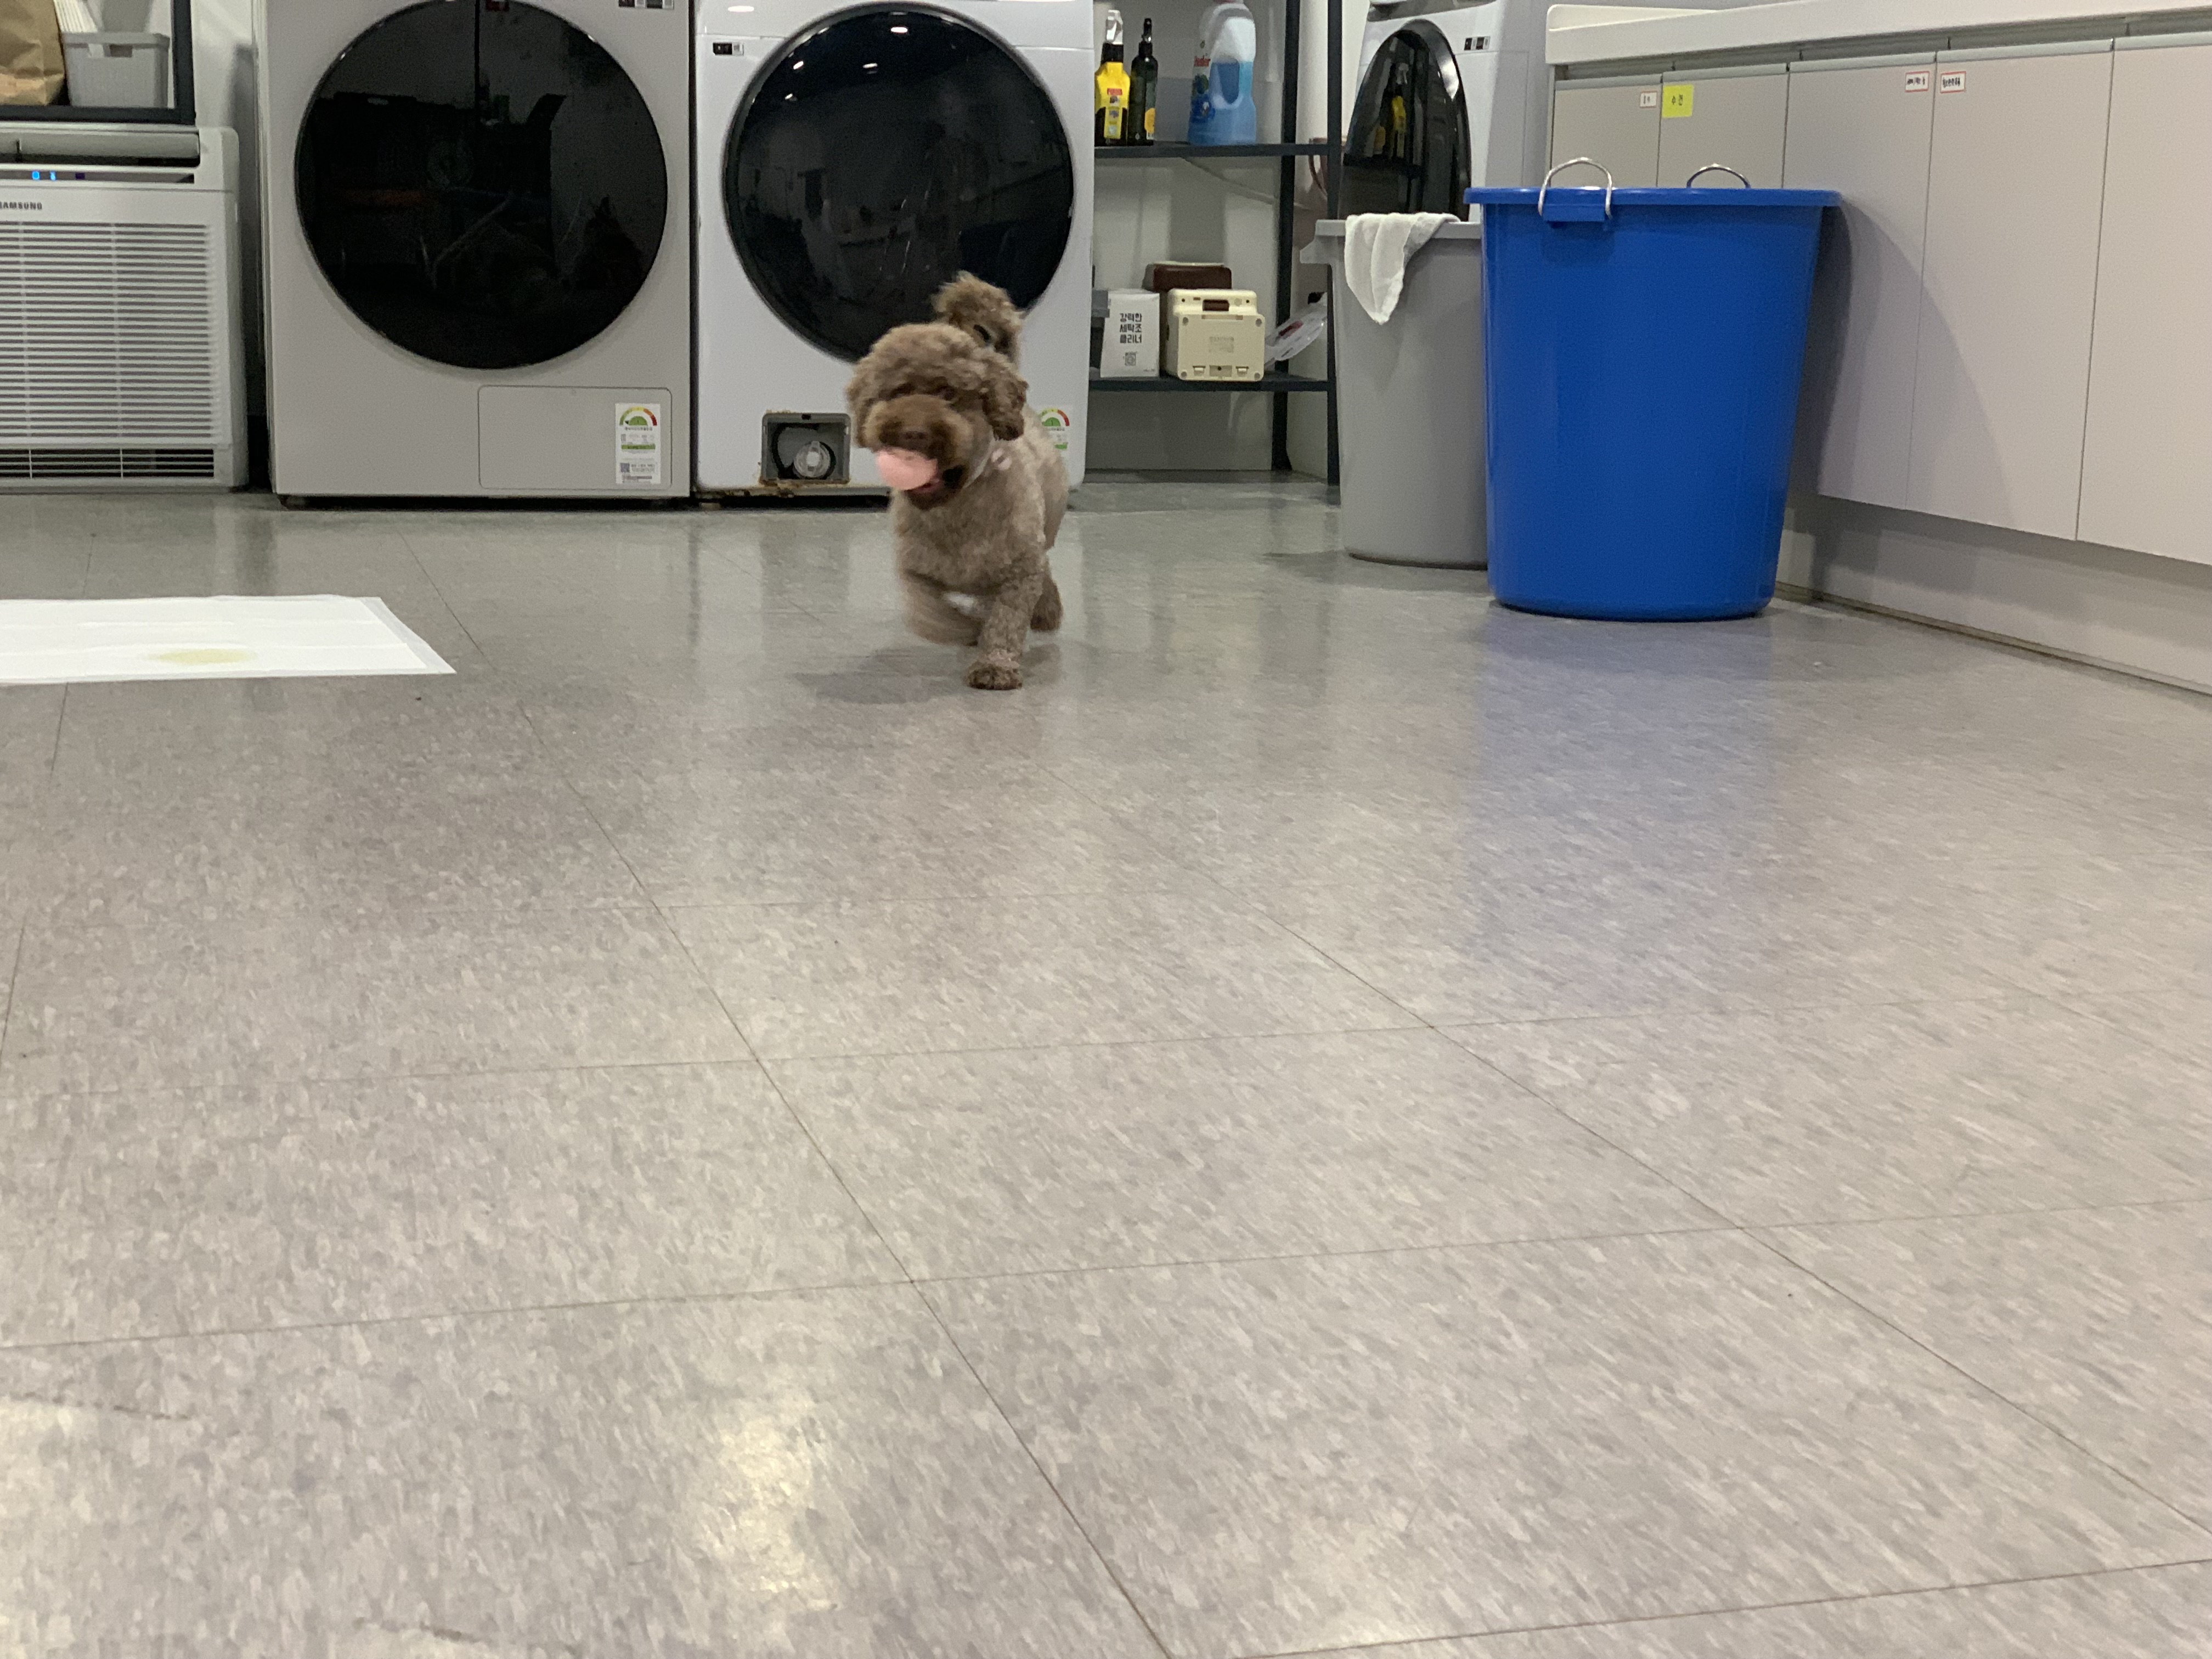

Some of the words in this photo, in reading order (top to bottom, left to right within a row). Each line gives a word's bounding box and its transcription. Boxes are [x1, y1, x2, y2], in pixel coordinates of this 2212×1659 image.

[1119, 313, 1142, 322] 강력한
[1119, 323, 1142, 332] 세탁조
[1120, 334, 1142, 343] 클리너
